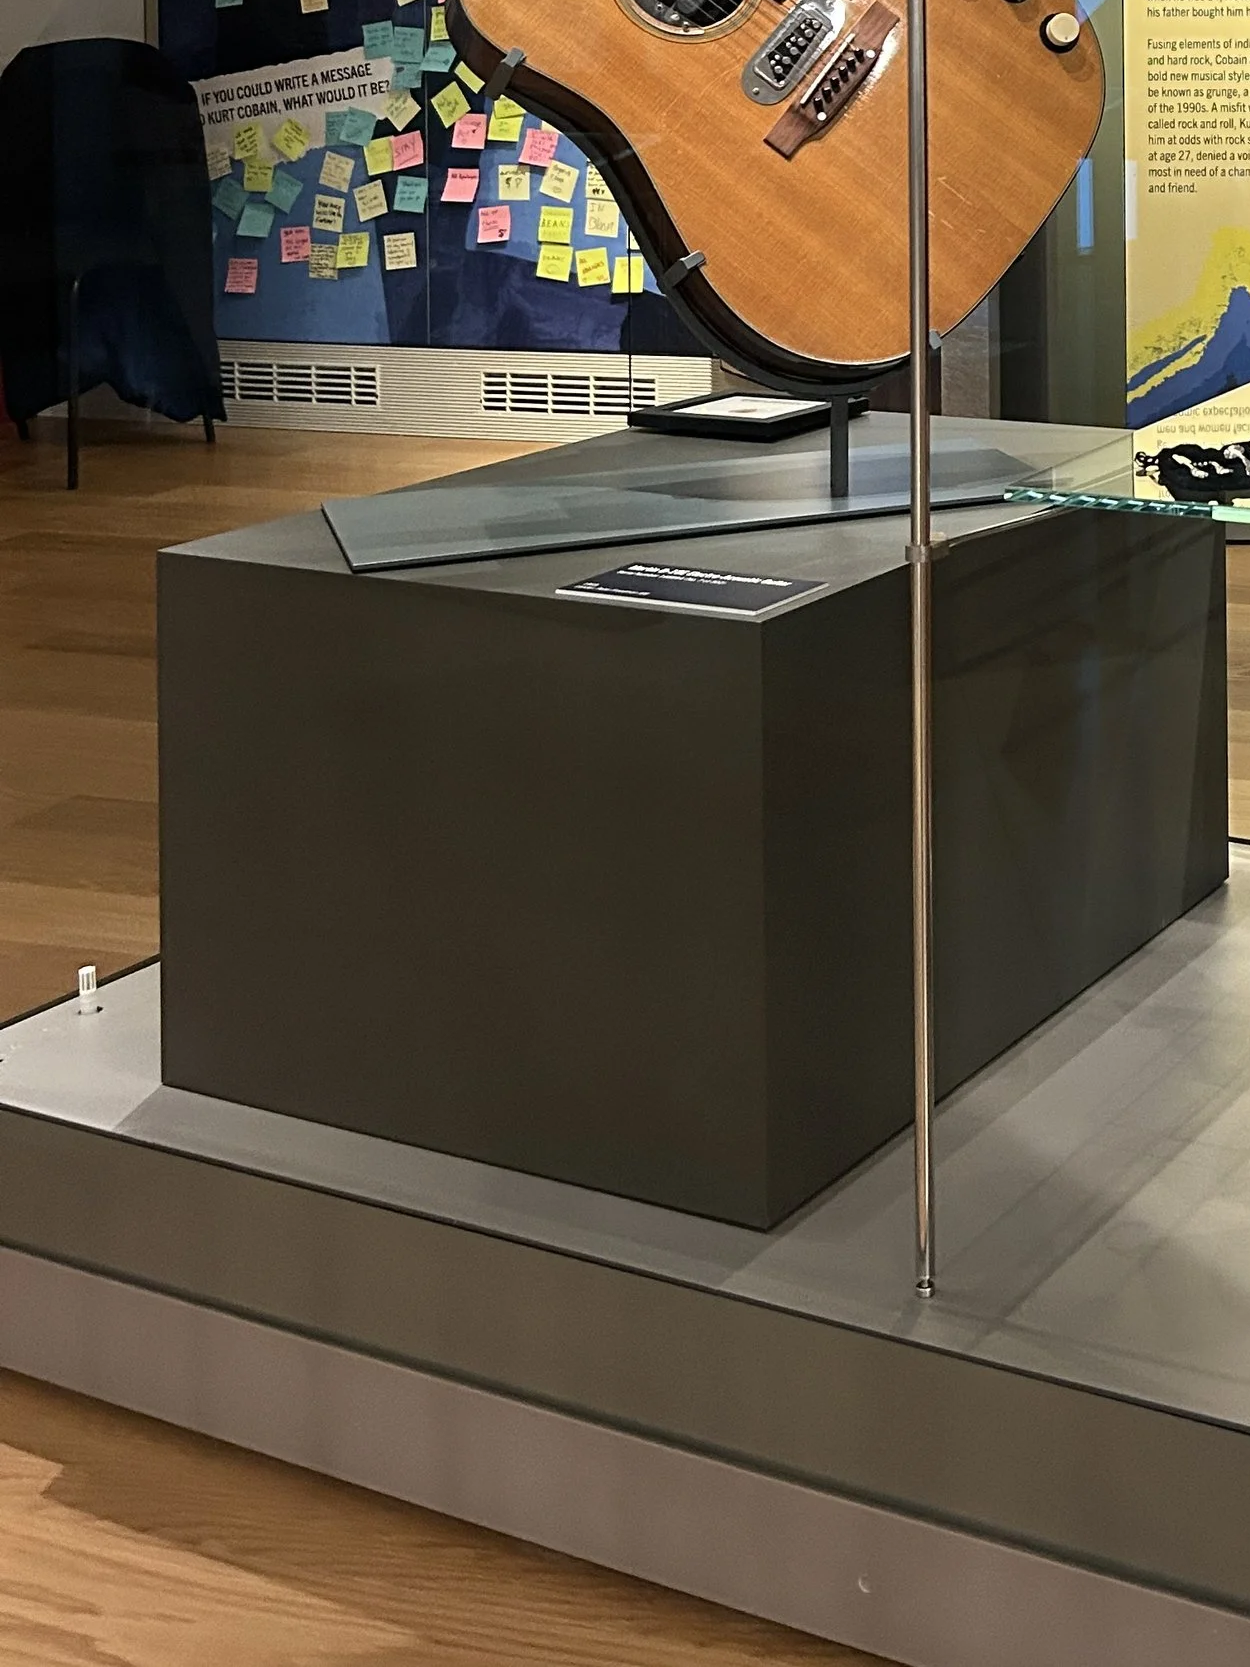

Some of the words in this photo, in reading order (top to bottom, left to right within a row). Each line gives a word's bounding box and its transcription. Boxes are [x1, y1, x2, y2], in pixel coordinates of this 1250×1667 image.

[202, 92, 213, 106] IF
[213, 89, 235, 104] YOU
[236, 81, 273, 100] COULD
[274, 73, 309, 92] WRITE
[311, 73, 319, 86] A
[320, 62, 373, 84] MESSAGE
[207, 109, 236, 125] KURT
[237, 100, 282, 119] COBAIN,
[283, 93, 314, 111] WHAT
[315, 86, 356, 104] WOULD
[357, 84, 368, 97] IT
[371, 79, 390, 95] BE?
